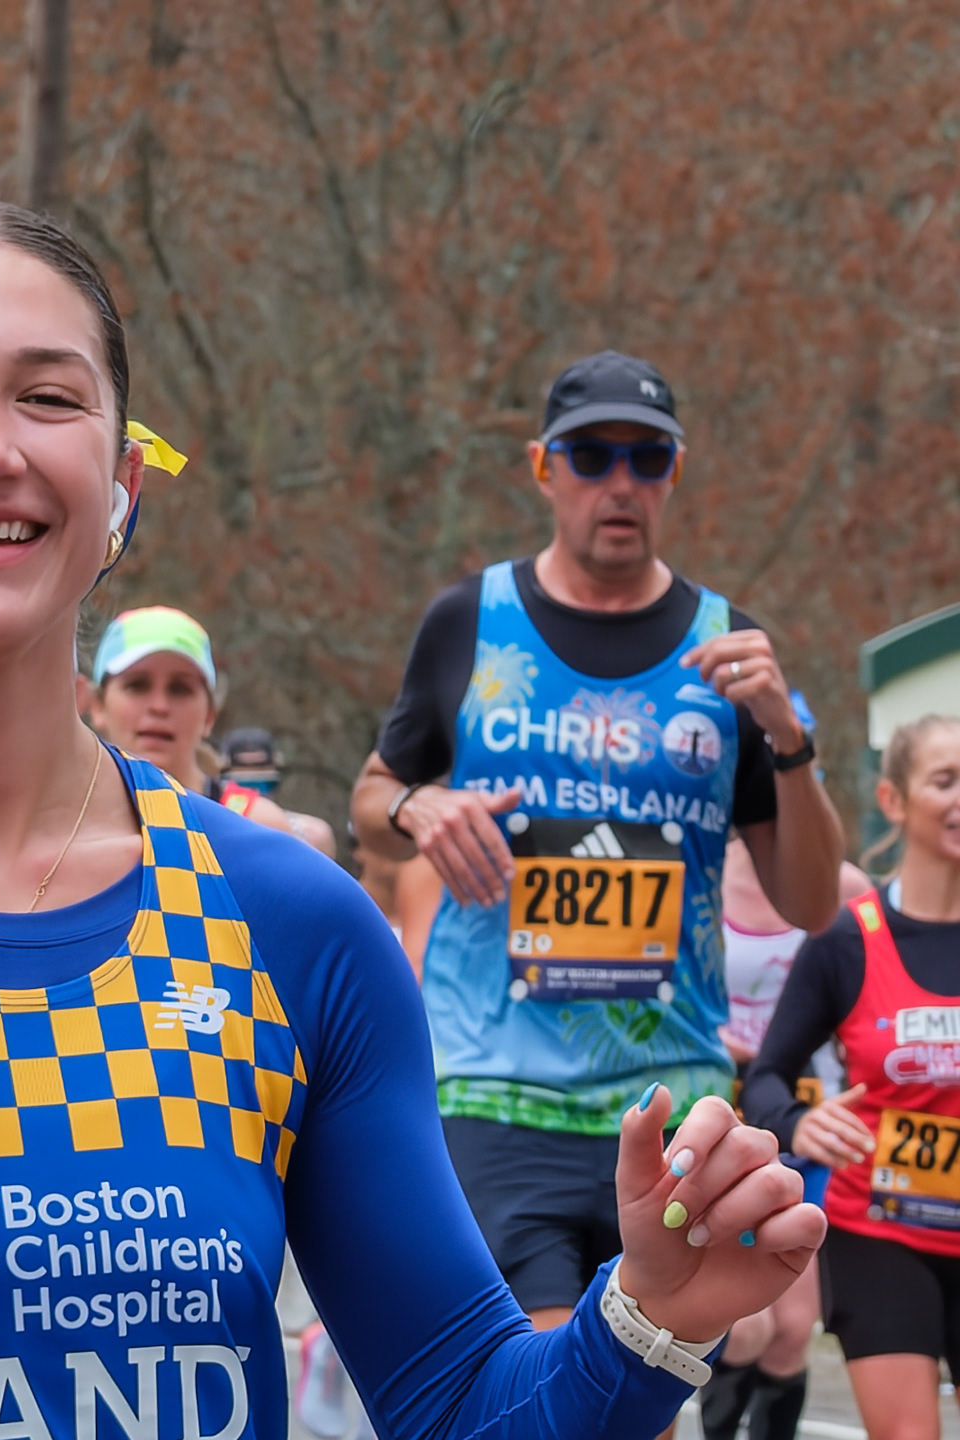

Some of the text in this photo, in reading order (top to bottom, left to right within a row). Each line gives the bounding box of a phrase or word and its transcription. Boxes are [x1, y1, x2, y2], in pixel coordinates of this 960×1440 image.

[482, 706, 641, 763] CHRIS
[524, 867, 670, 928] 28217
[890, 1118, 960, 1173] 287
[1, 1182, 186, 1229] Boston
[6, 1228, 243, 1280] Children's
[13, 1279, 221, 1337] Hospital
